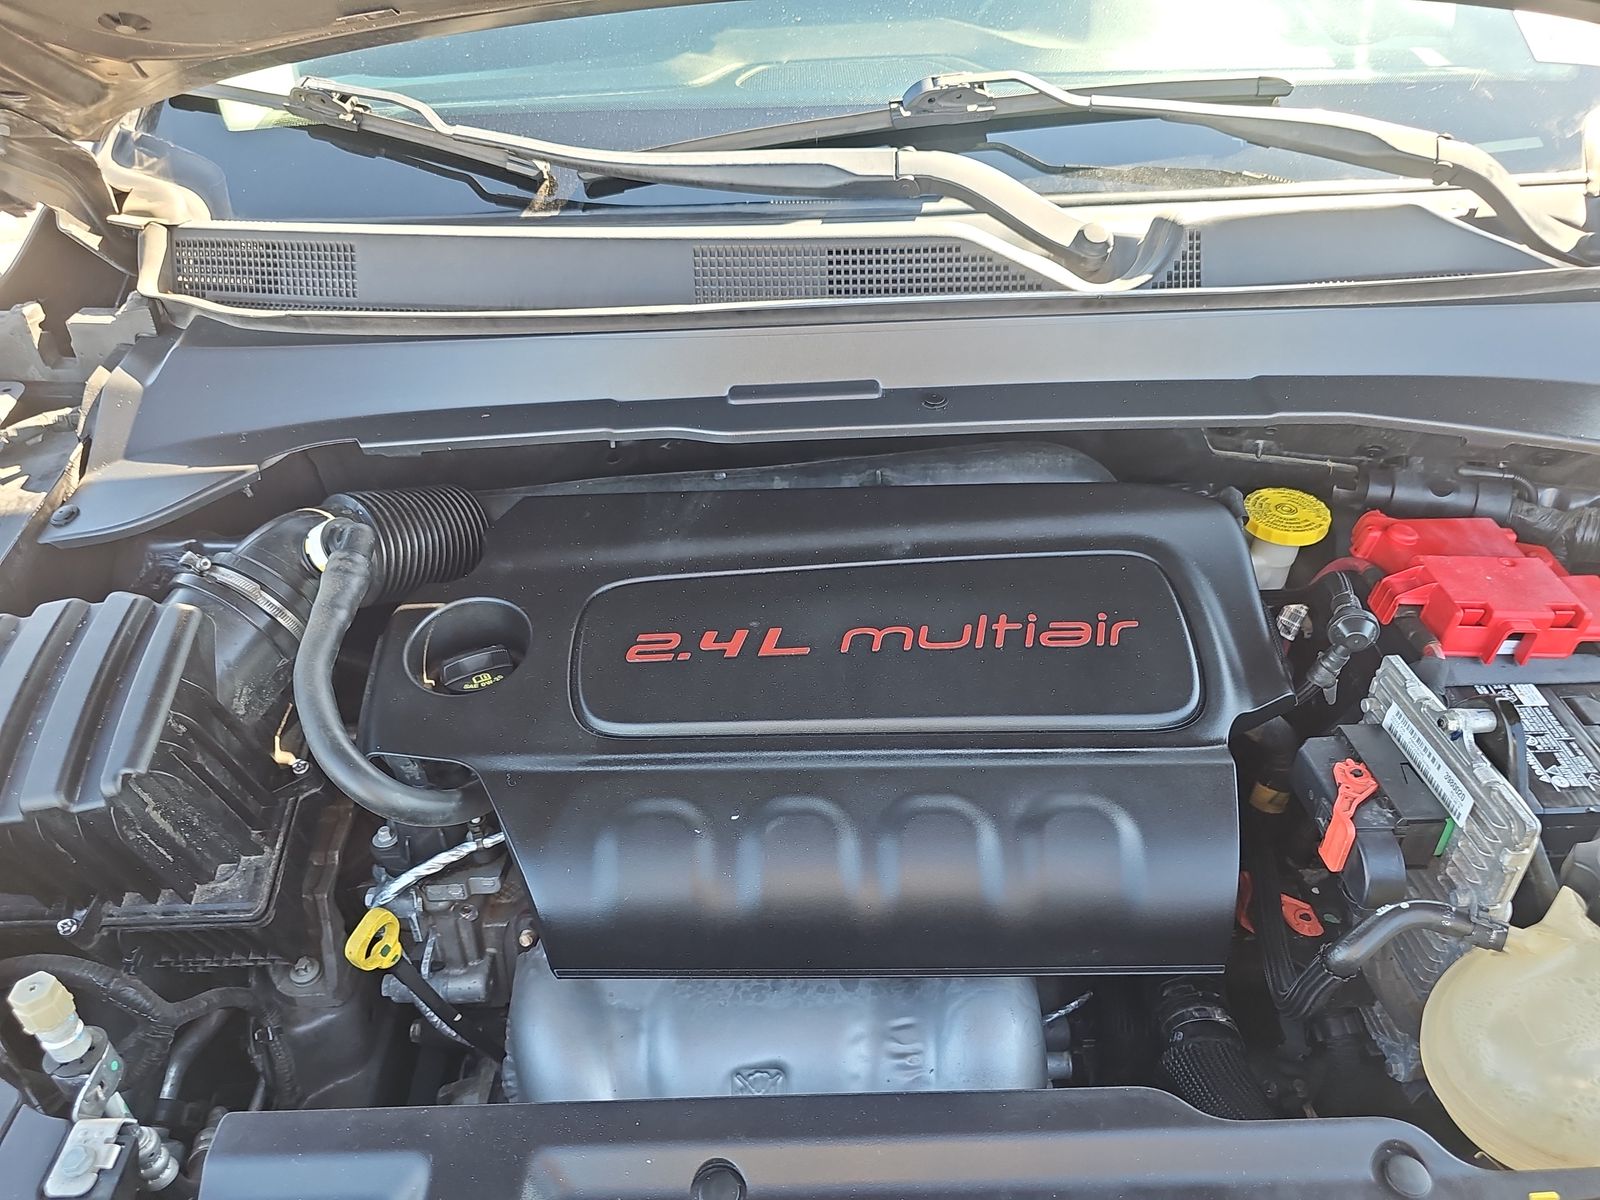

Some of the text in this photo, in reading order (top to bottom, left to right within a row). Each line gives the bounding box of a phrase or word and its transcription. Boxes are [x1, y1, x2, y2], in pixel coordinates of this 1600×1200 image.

[625, 612, 1139, 663] 2.4L multiair
[463, 682, 479, 690] SAE
